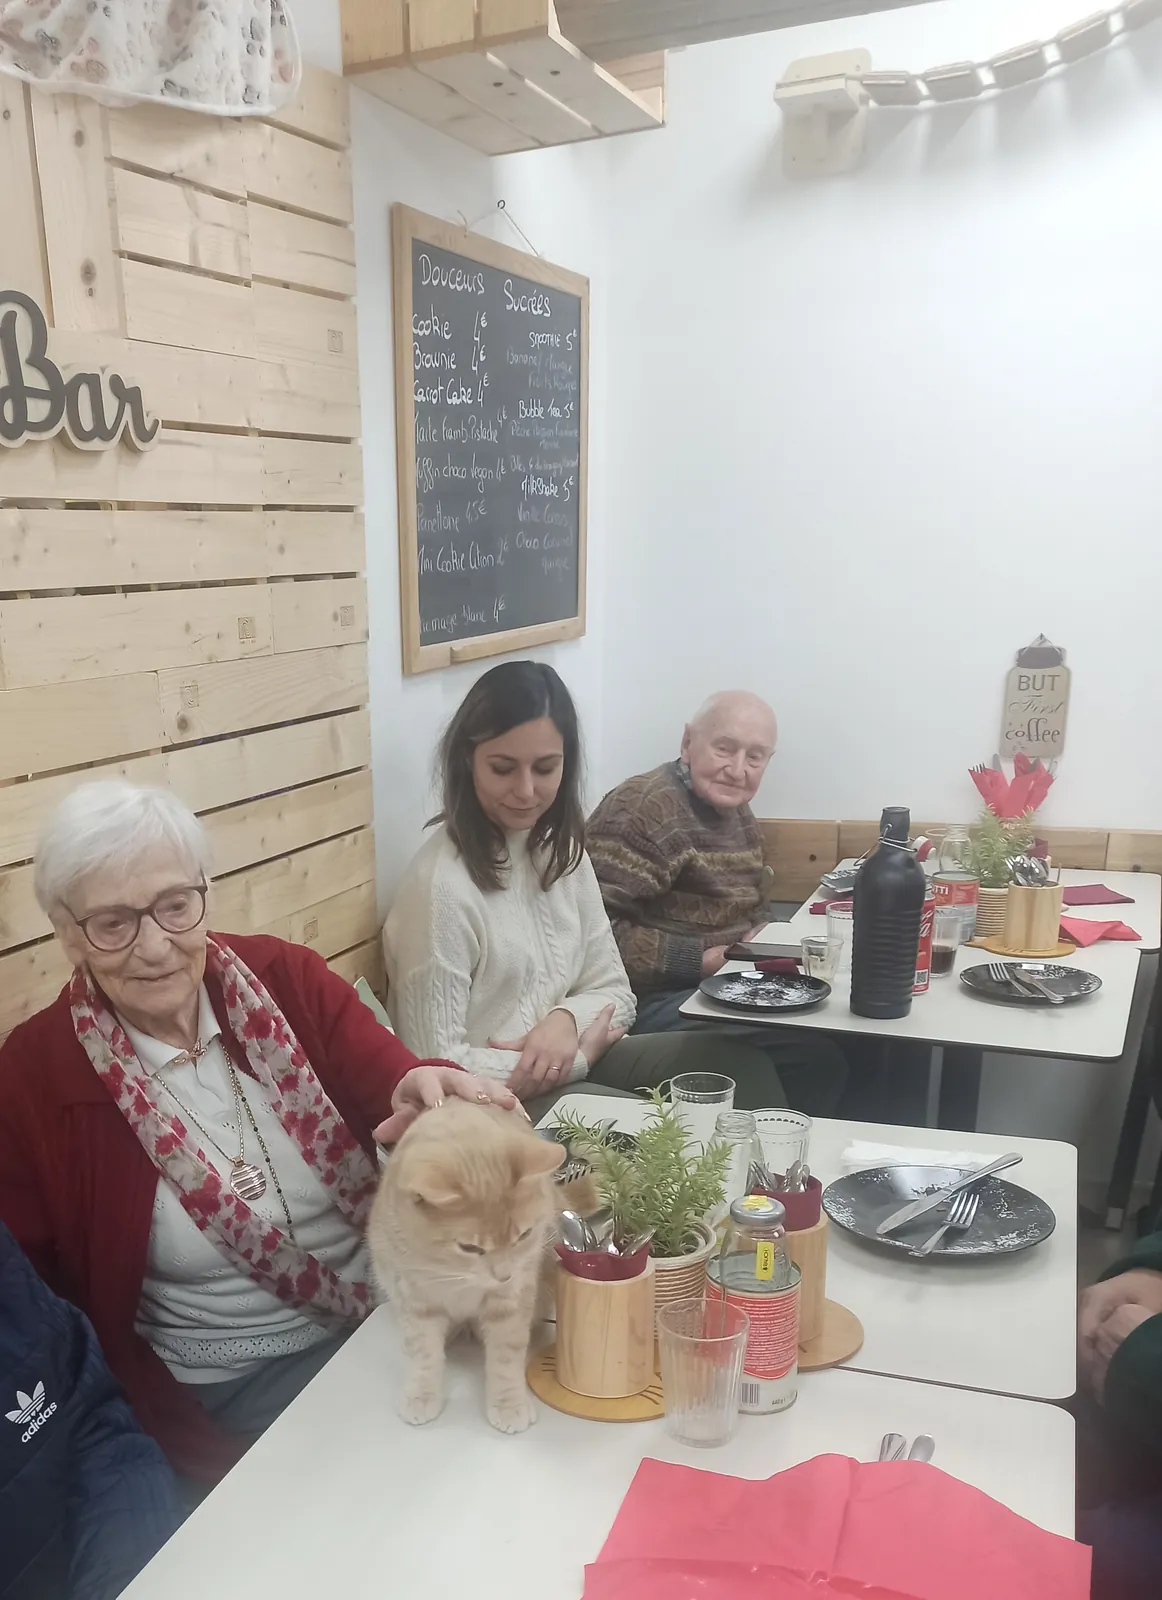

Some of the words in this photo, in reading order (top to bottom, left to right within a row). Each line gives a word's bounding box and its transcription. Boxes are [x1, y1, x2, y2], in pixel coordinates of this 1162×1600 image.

[418, 254, 485, 295] Douceurs
[504, 279, 551, 317] Sucrées
[0, 290, 160, 443] Bar
[413, 341, 456, 370] Brownie
[413, 379, 444, 405] Carrot
[446, 378, 473, 405] Cake
[518, 399, 544, 419] Bubble
[547, 398, 562, 417] Tea
[436, 542, 465, 573] Cookie
[1018, 674, 1061, 691] BUT
[1008, 699, 1063, 714] First
[1005, 717, 1060, 742] coffee
[21, 1402, 58, 1443] adidas
